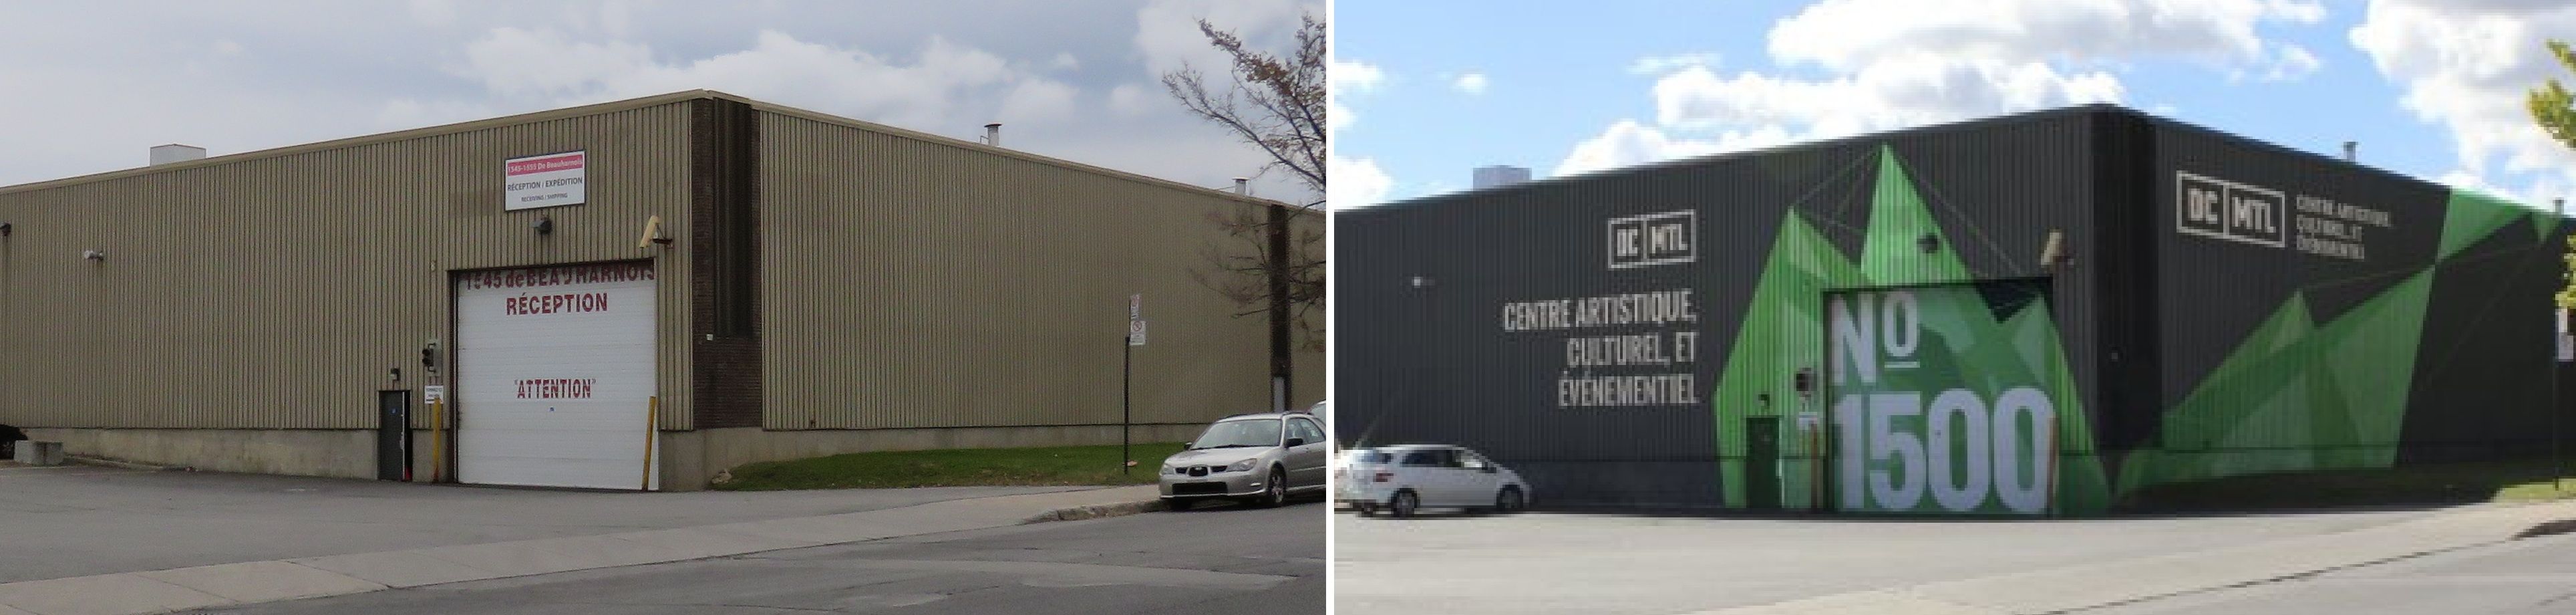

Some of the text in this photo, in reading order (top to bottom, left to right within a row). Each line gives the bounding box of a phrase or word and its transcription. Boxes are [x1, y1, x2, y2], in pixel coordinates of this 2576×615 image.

[507, 181, 541, 191] RÉCEPTION
[545, 176, 583, 187] EXPÉDITION
[2232, 197, 2276, 233] MTL
[1652, 224, 1688, 253] MTL
[506, 292, 608, 316] RÉCEPTION
[1504, 299, 1571, 331] CENTRE
[1675, 332, 1699, 362] ET
[1830, 388, 2056, 513] 1500
